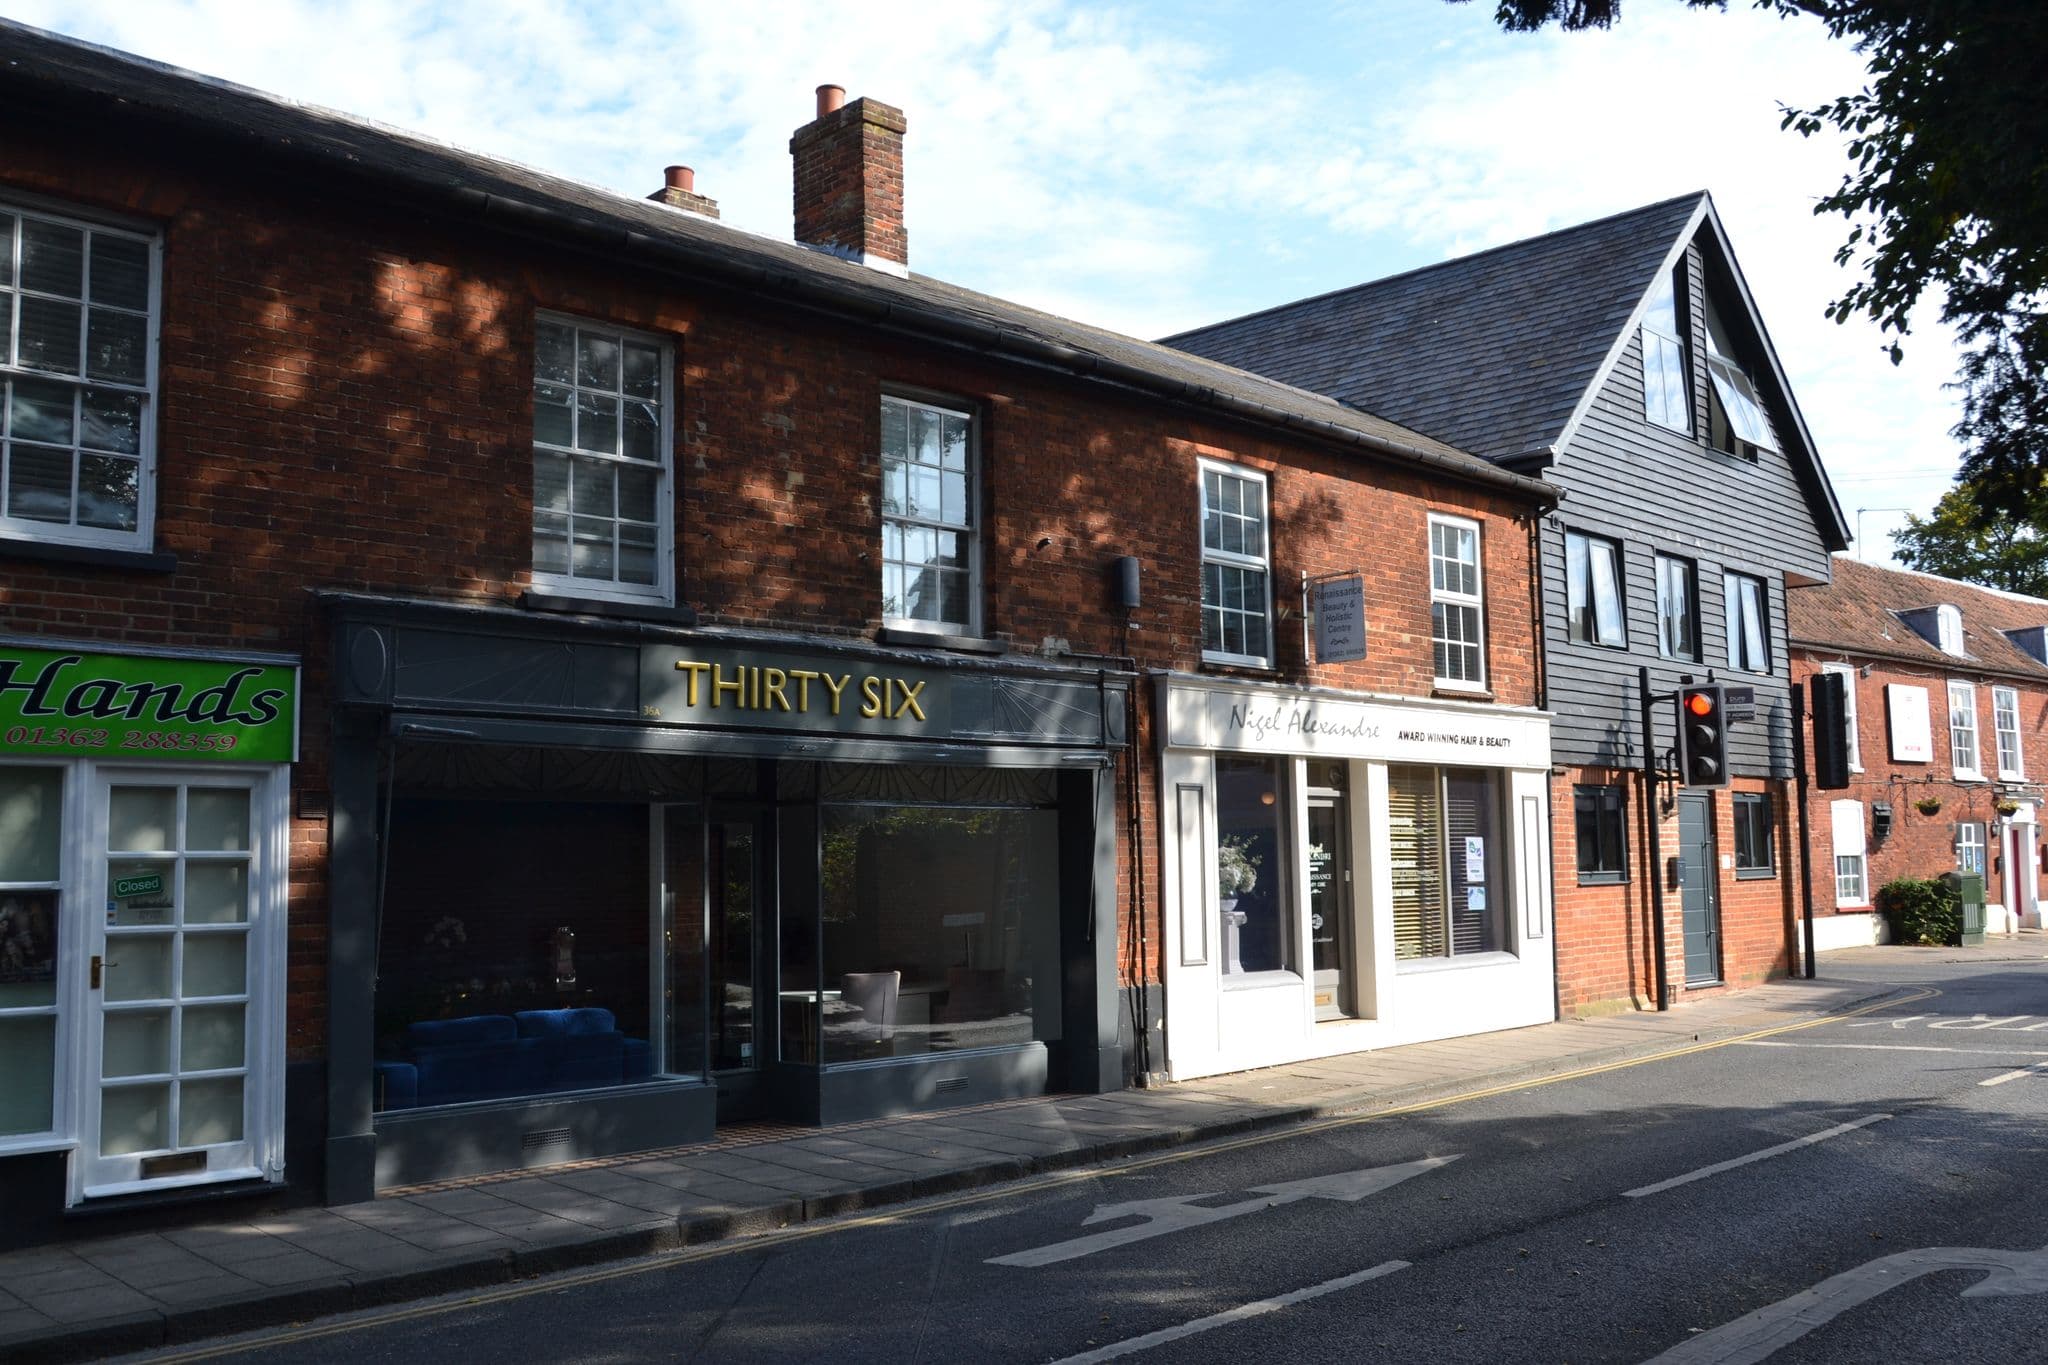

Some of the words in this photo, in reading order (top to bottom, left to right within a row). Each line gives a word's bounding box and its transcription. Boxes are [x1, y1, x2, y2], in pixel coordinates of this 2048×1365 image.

[0, 656, 288, 727] Hands
[675, 660, 850, 715] THIRTY
[861, 676, 926, 721] SIX
[1229, 704, 1281, 741] Nigel
[1288, 708, 1379, 738] Alexandre
[6, 726, 109, 747] 01362
[120, 730, 238, 752] 288359
[1398, 730, 1425, 742] AWARD
[1427, 732, 1458, 744] WINNING
[1461, 735, 1477, 745] HAIR
[1479, 737, 1484, 746] &
[1486, 737, 1511, 748] BEAUTY
[119, 878, 159, 893] Closed
